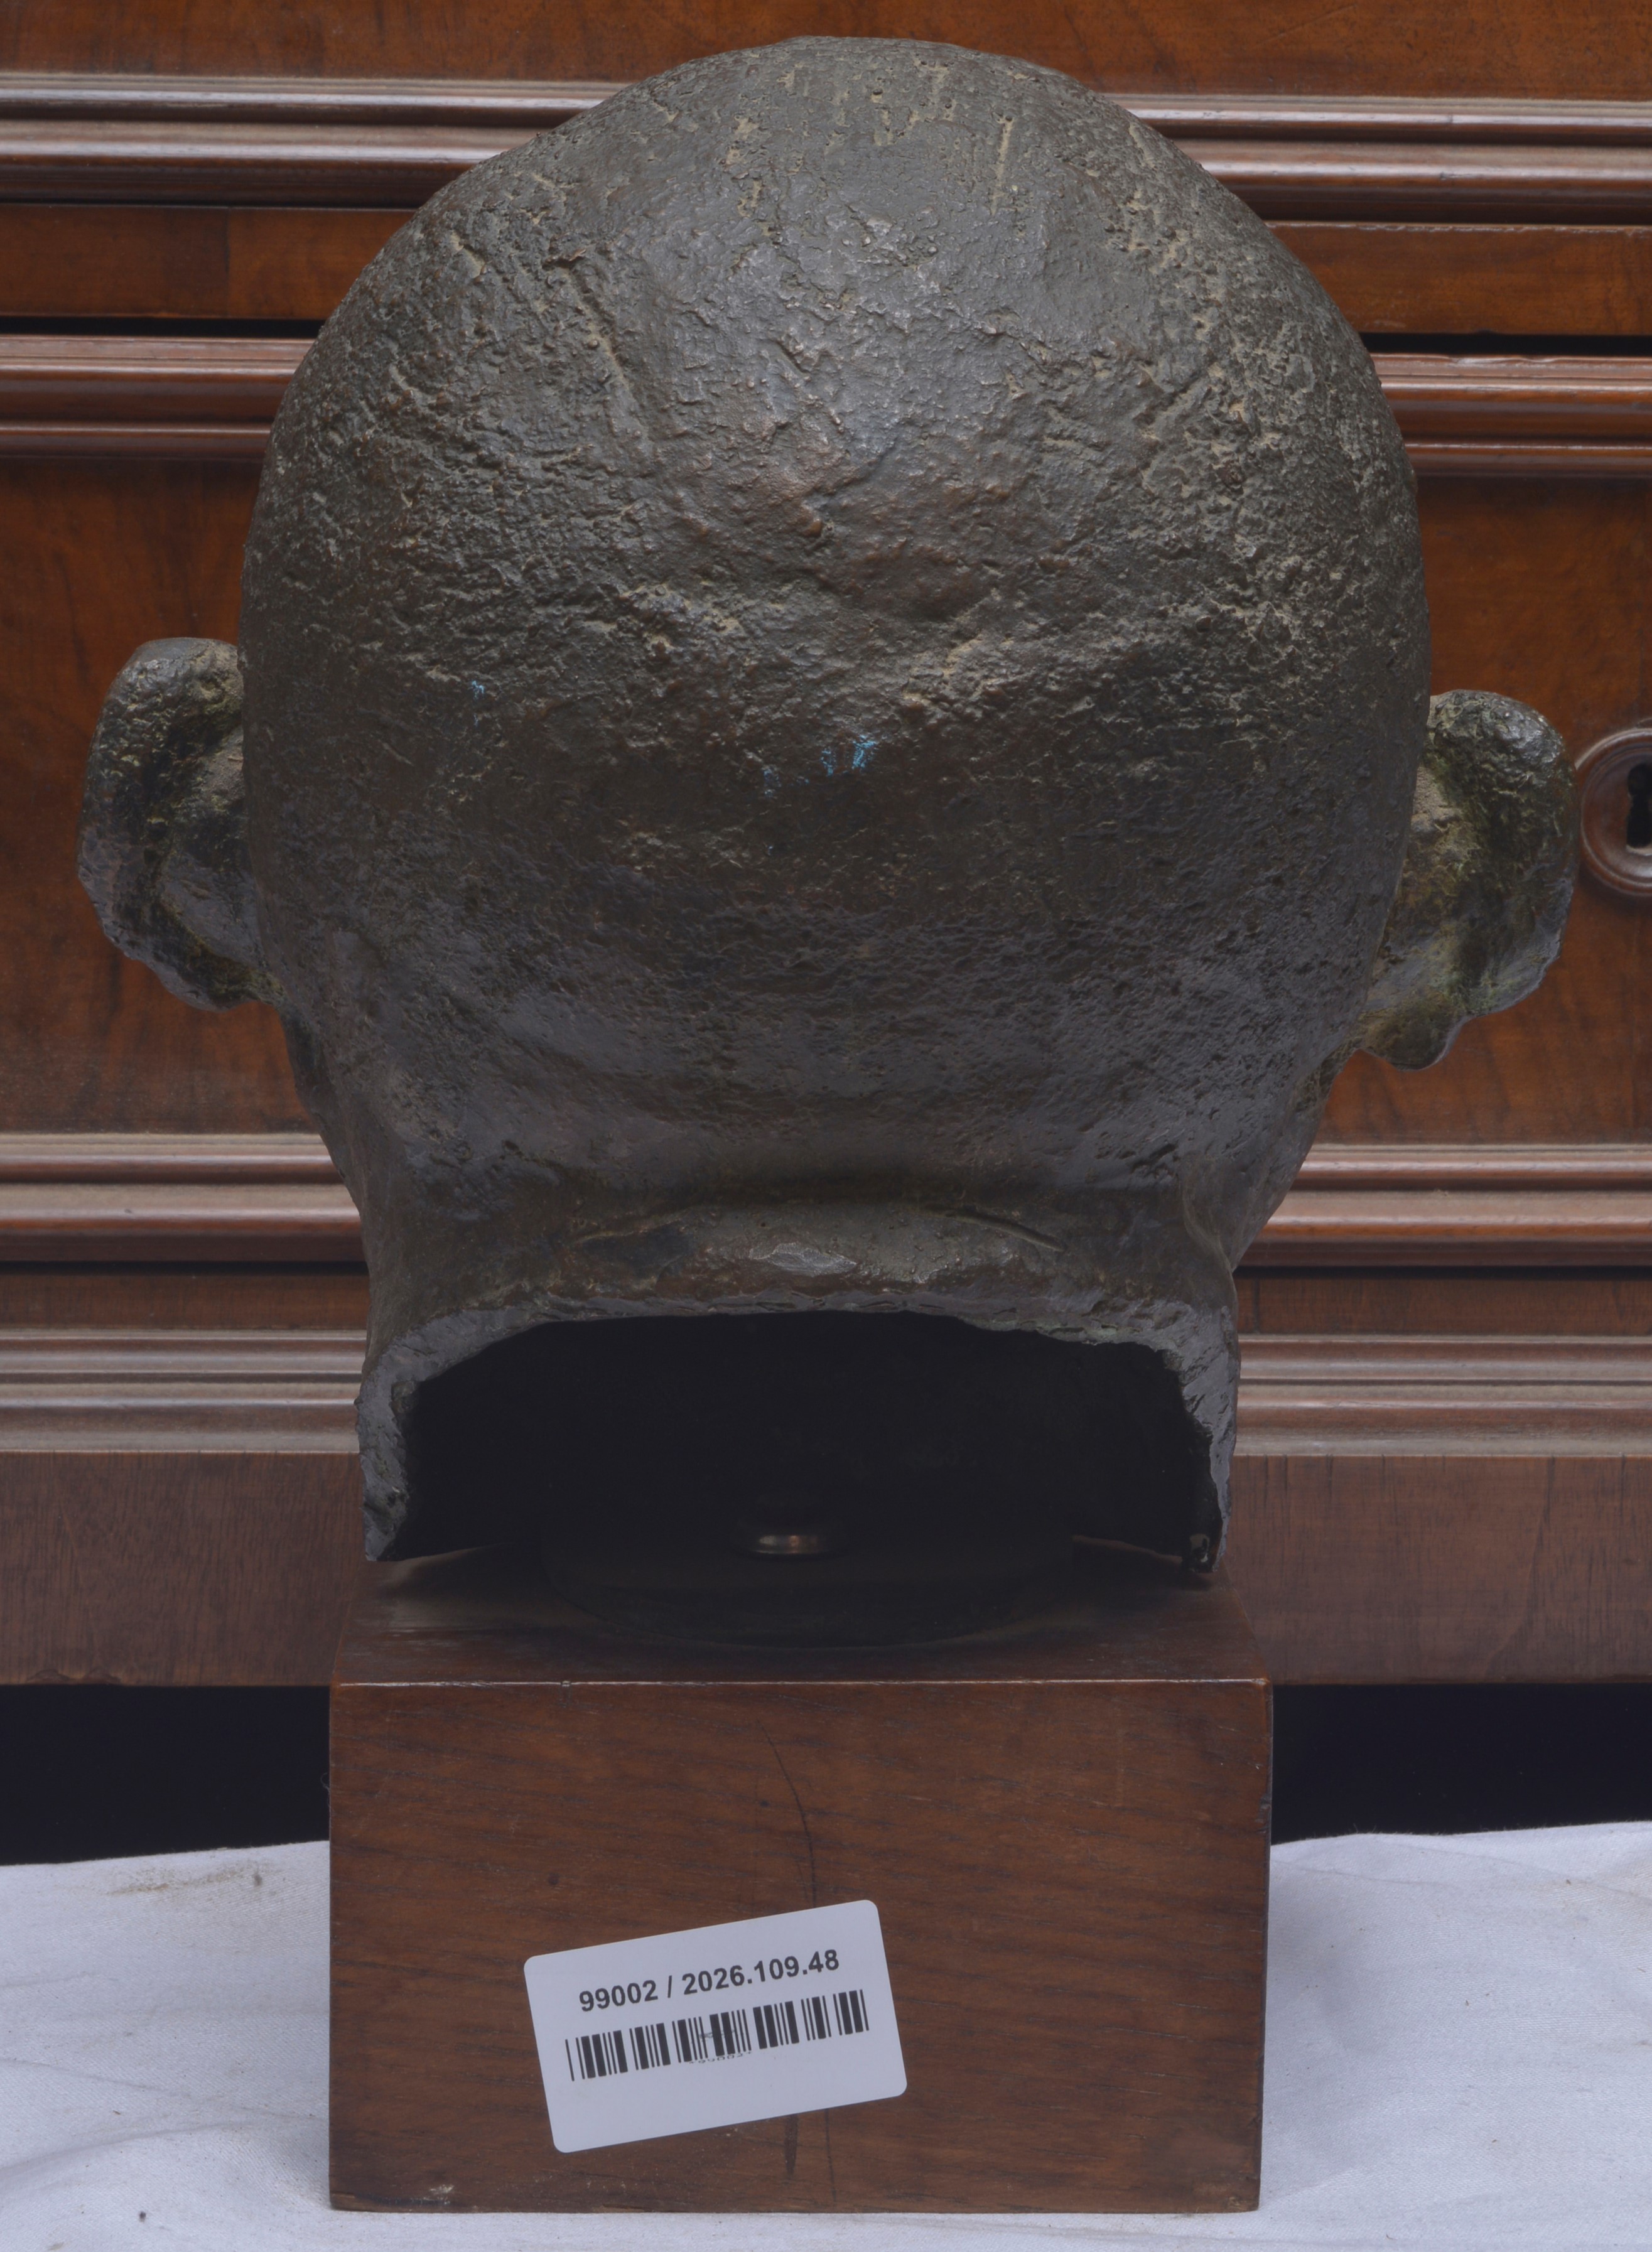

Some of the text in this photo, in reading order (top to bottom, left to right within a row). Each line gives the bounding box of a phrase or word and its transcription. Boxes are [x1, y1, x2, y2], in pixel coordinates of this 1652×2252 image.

[579, 1949, 839, 2012] 99002 / 2026.109.48
